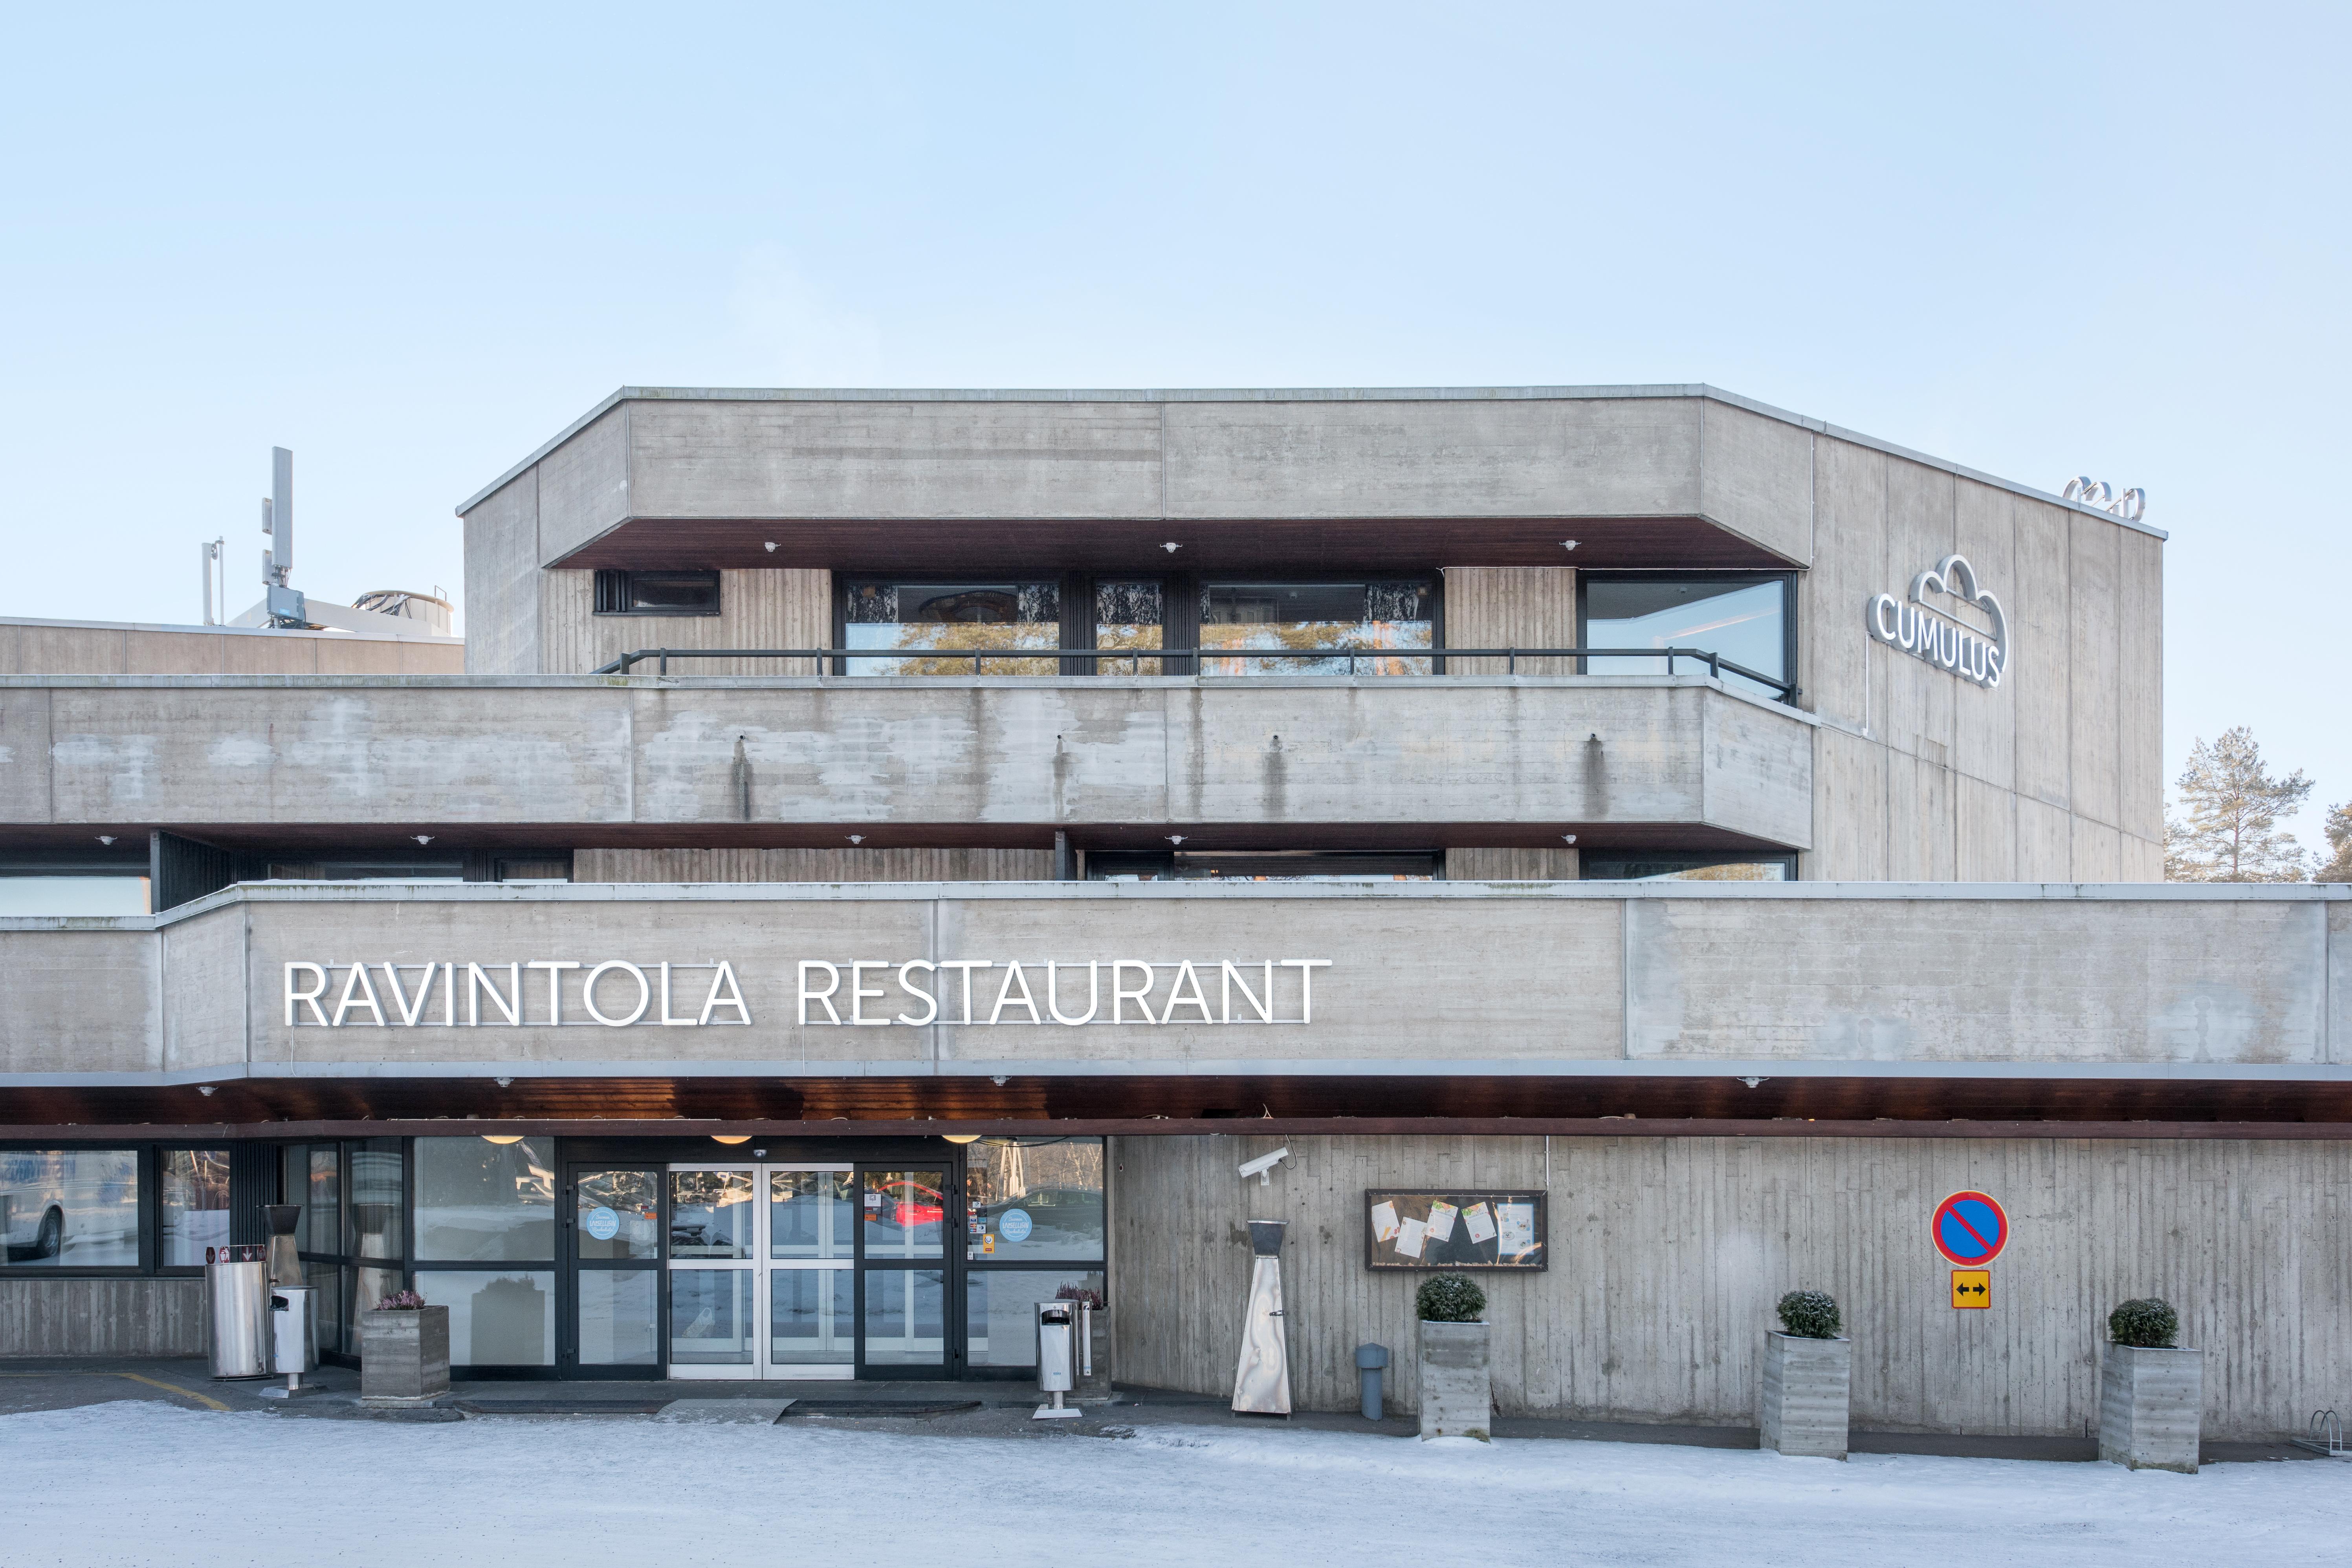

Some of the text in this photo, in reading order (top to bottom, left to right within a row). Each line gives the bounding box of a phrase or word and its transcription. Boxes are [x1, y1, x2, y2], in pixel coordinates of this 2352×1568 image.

[1877, 592, 2000, 688] CUMULUS
[284, 959, 1333, 1027] RAVINTOLA RESTAURANT
